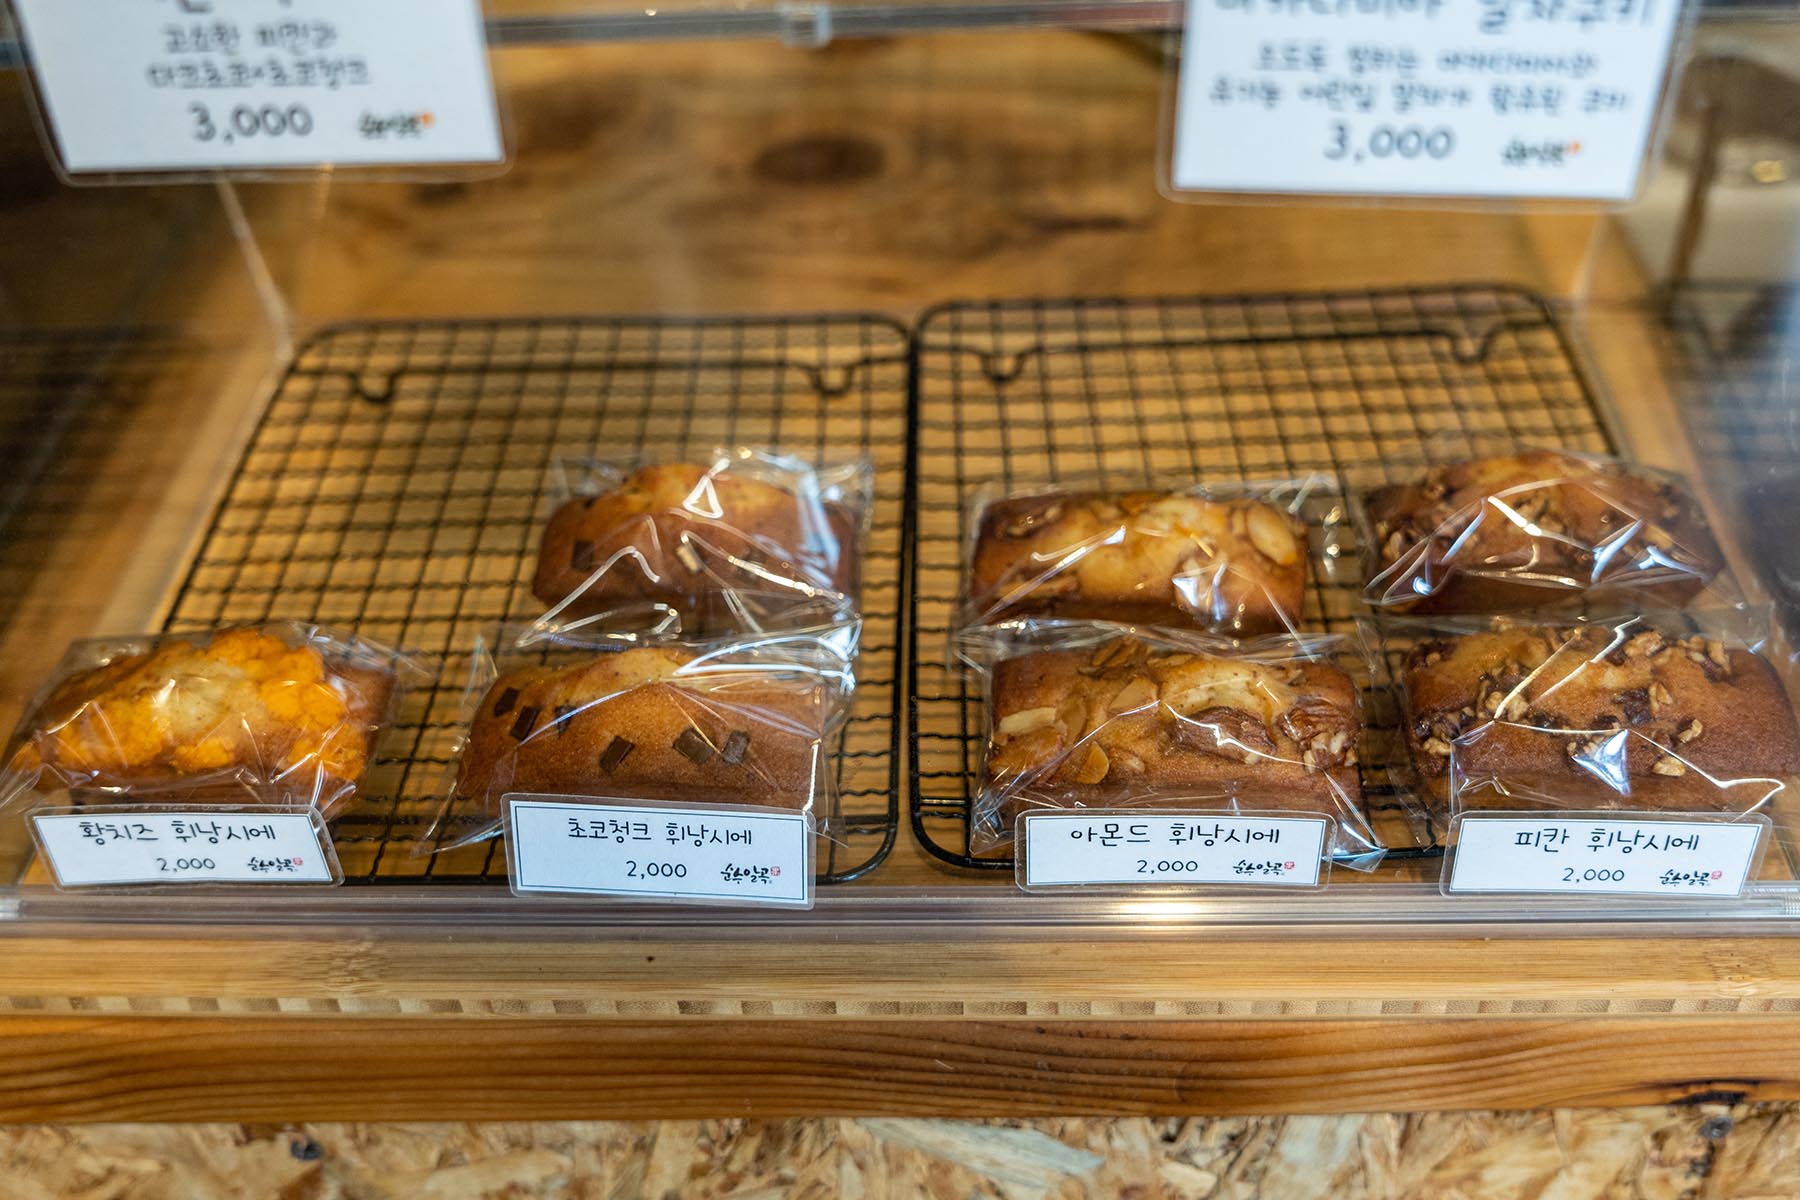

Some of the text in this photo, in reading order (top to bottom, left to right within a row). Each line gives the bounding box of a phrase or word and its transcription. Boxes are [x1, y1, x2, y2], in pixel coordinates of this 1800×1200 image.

[189, 102, 313, 144] 3,000
[1323, 120, 1455, 164] 3,000
[79, 820, 276, 845] 황치즈 휘낭시에
[568, 817, 752, 848] 초코청크 휘낭시에
[1070, 823, 1280, 847] 아몬드 휘낭시에
[1514, 828, 1700, 854] 피칸 휘낭시에
[156, 857, 216, 872] 2,000
[626, 860, 688, 880] 2,000
[1136, 860, 1199, 875] 2,000
[1561, 867, 1626, 884] 2,000
